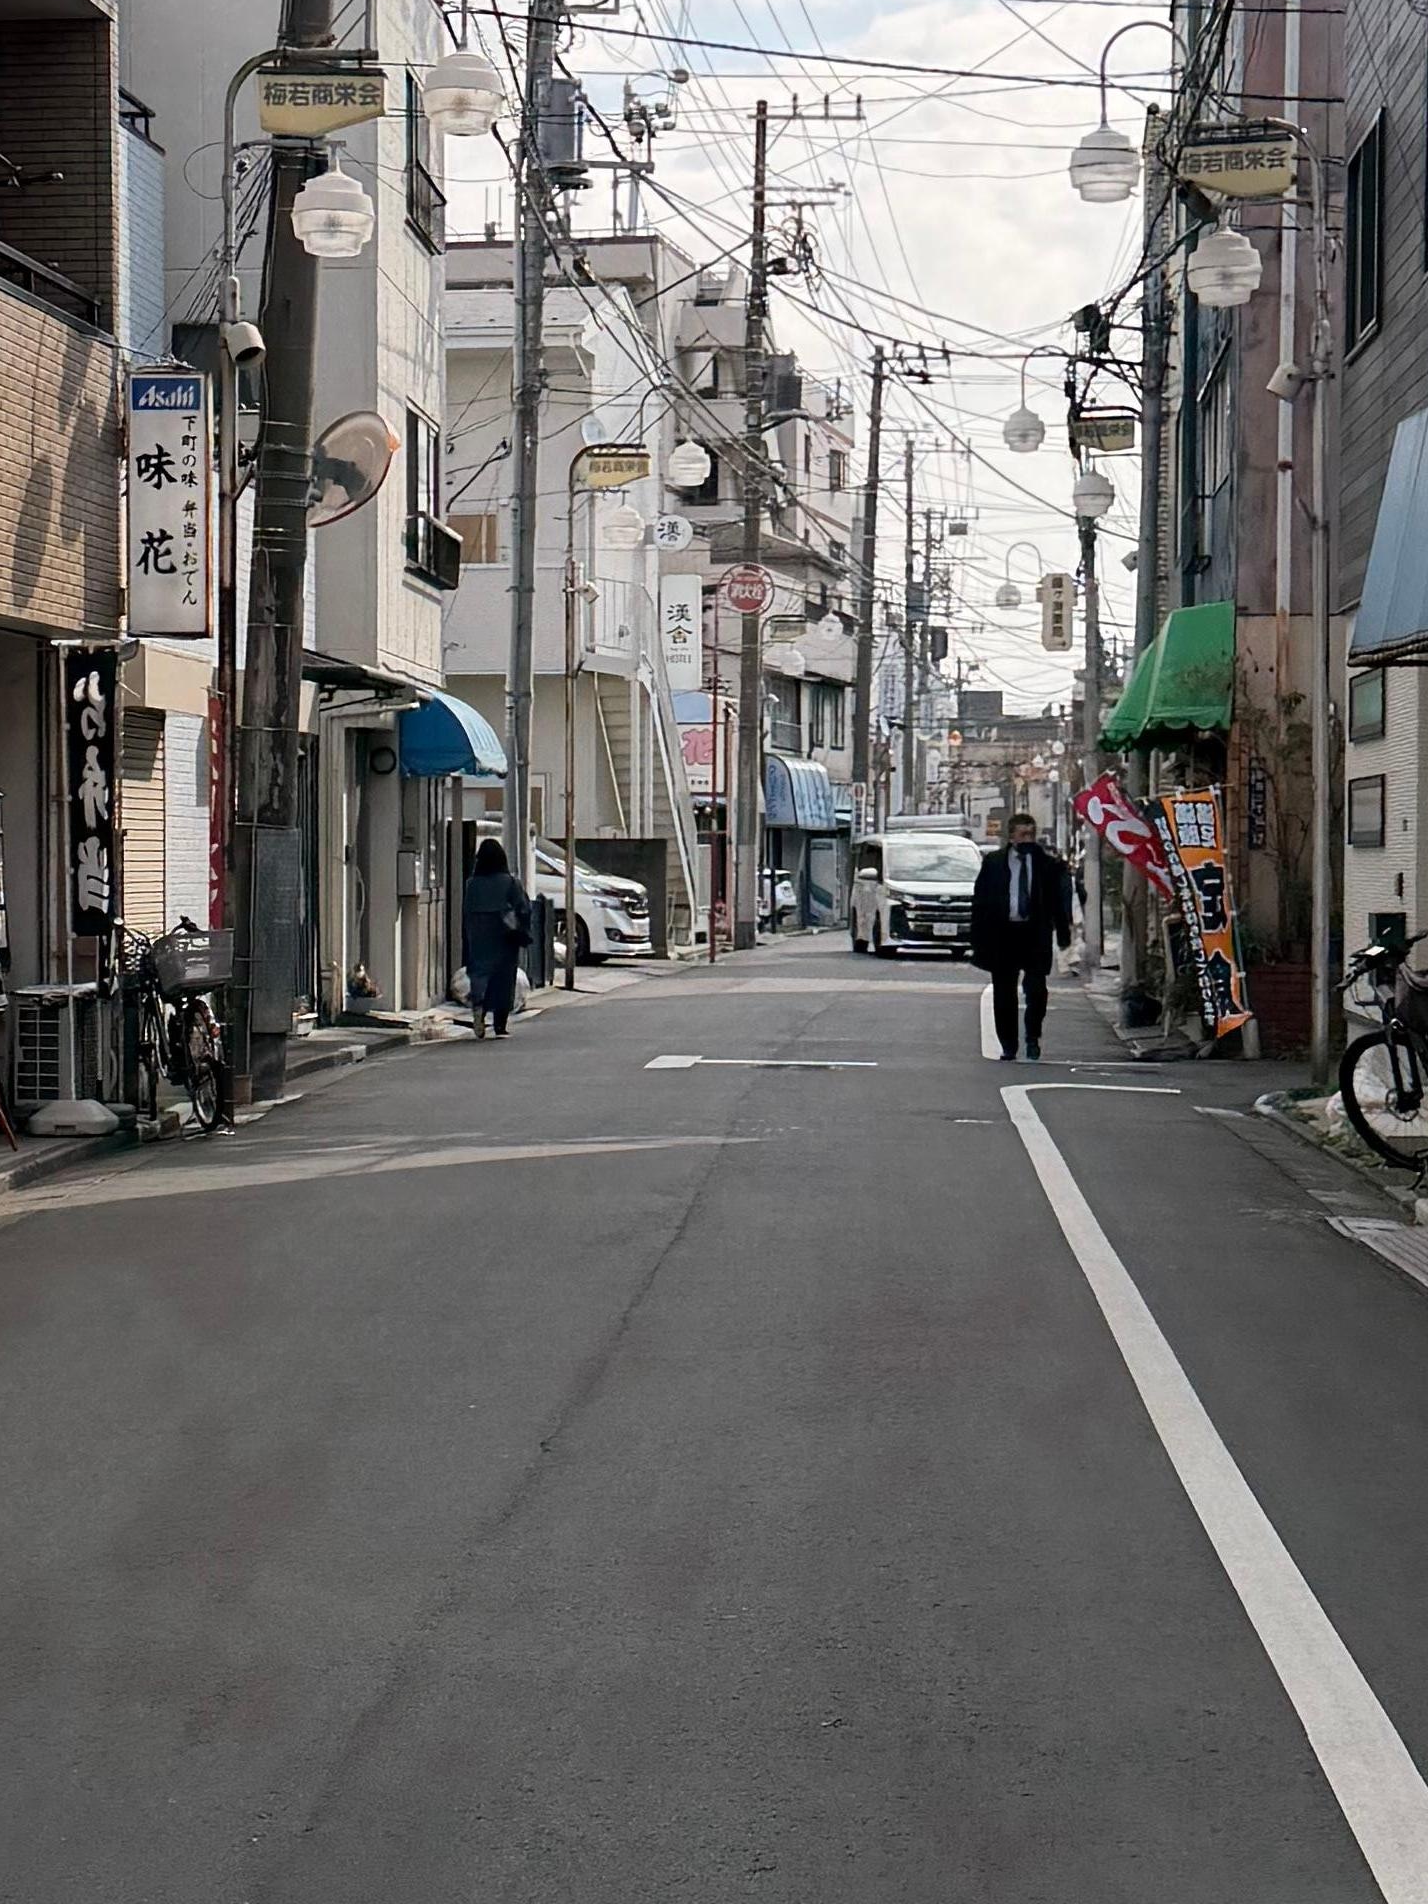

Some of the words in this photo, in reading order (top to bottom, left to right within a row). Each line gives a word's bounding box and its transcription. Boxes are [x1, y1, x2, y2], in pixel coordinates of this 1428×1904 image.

[264, 82, 380, 106] 梅若商栄会
[137, 384, 195, 408] Asahi
[180, 415, 199, 488] 下町の味
[135, 443, 178, 576] 味花
